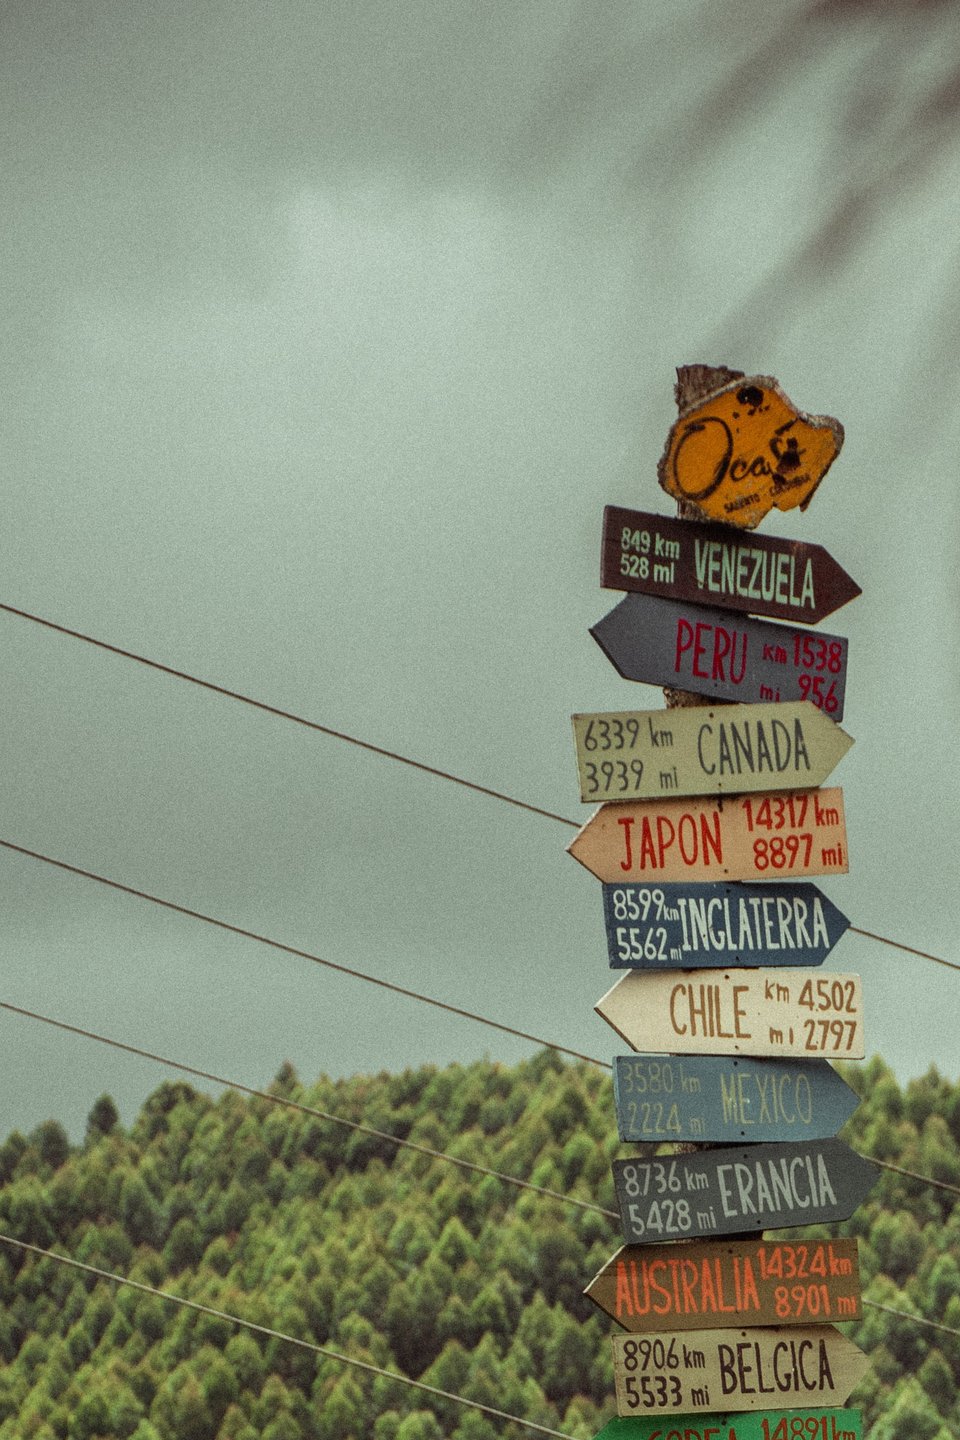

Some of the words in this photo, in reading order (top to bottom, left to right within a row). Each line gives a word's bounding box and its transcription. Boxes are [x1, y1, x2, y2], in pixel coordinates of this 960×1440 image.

[621, 527, 650, 553] 849
[655, 533, 680, 560] km
[621, 556, 649, 579] 528
[694, 539, 816, 609] VENEZUELA
[674, 618, 747, 684] PERU
[763, 642, 787, 664] km
[793, 634, 842, 673] 1538
[760, 683, 780, 701] mi
[798, 674, 838, 712] 956
[584, 718, 639, 751] 6339
[649, 718, 673, 748] km
[697, 718, 810, 775] CANADA
[585, 760, 644, 792] 3939
[660, 768, 678, 789] mi
[742, 796, 808, 831] 14317
[814, 795, 839, 826] km
[618, 811, 722, 871] JAPON
[754, 834, 812, 871] 8897
[822, 844, 843, 867] mi
[663, 904, 679, 921] km
[678, 898, 829, 951] INGLATERRA
[765, 981, 789, 1003] km
[670, 984, 752, 1038] CHILE
[720, 1073, 812, 1125] MEXICO
[684, 1167, 709, 1191] km
[697, 1206, 716, 1230] mi
[829, 1246, 852, 1276] km
[616, 1258, 760, 1317] AUSTRALIA
[775, 1286, 831, 1318] 8901
[837, 1296, 857, 1315] mi
[684, 1345, 705, 1369] km
[718, 1339, 835, 1395] BELGICA
[626, 1375, 683, 1408] 5533
[691, 1387, 710, 1406] mi
